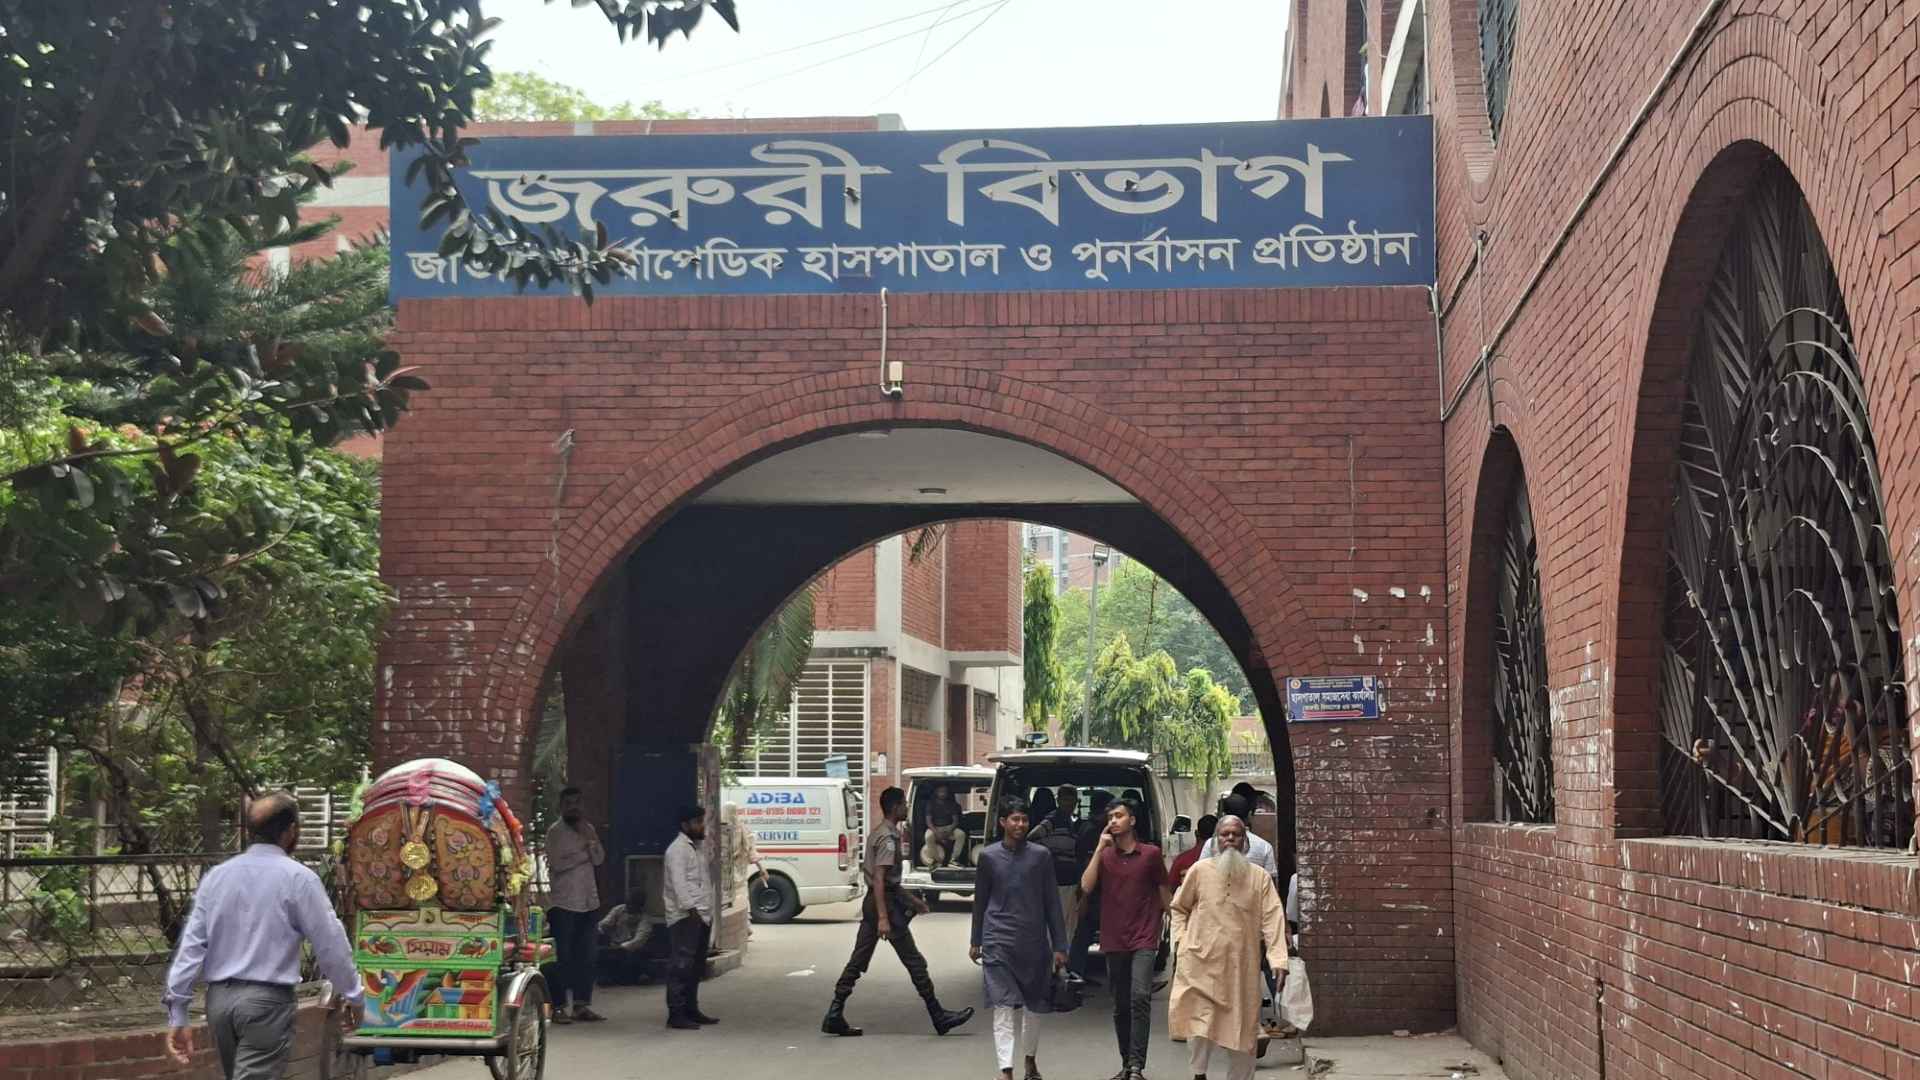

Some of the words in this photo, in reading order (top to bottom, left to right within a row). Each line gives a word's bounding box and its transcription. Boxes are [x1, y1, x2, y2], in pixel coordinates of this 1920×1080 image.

[469, 140, 893, 231] জরুরী
[920, 139, 1353, 226] বিভাগ
[797, 242, 1006, 282] হাসপাতাল
[1019, 246, 1053, 272] ও
[1071, 228, 1241, 282] পুনর্বাসন
[1252, 220, 1418, 266] প্রতিষ্ঠান
[757, 831, 799, 841] SERVICE
